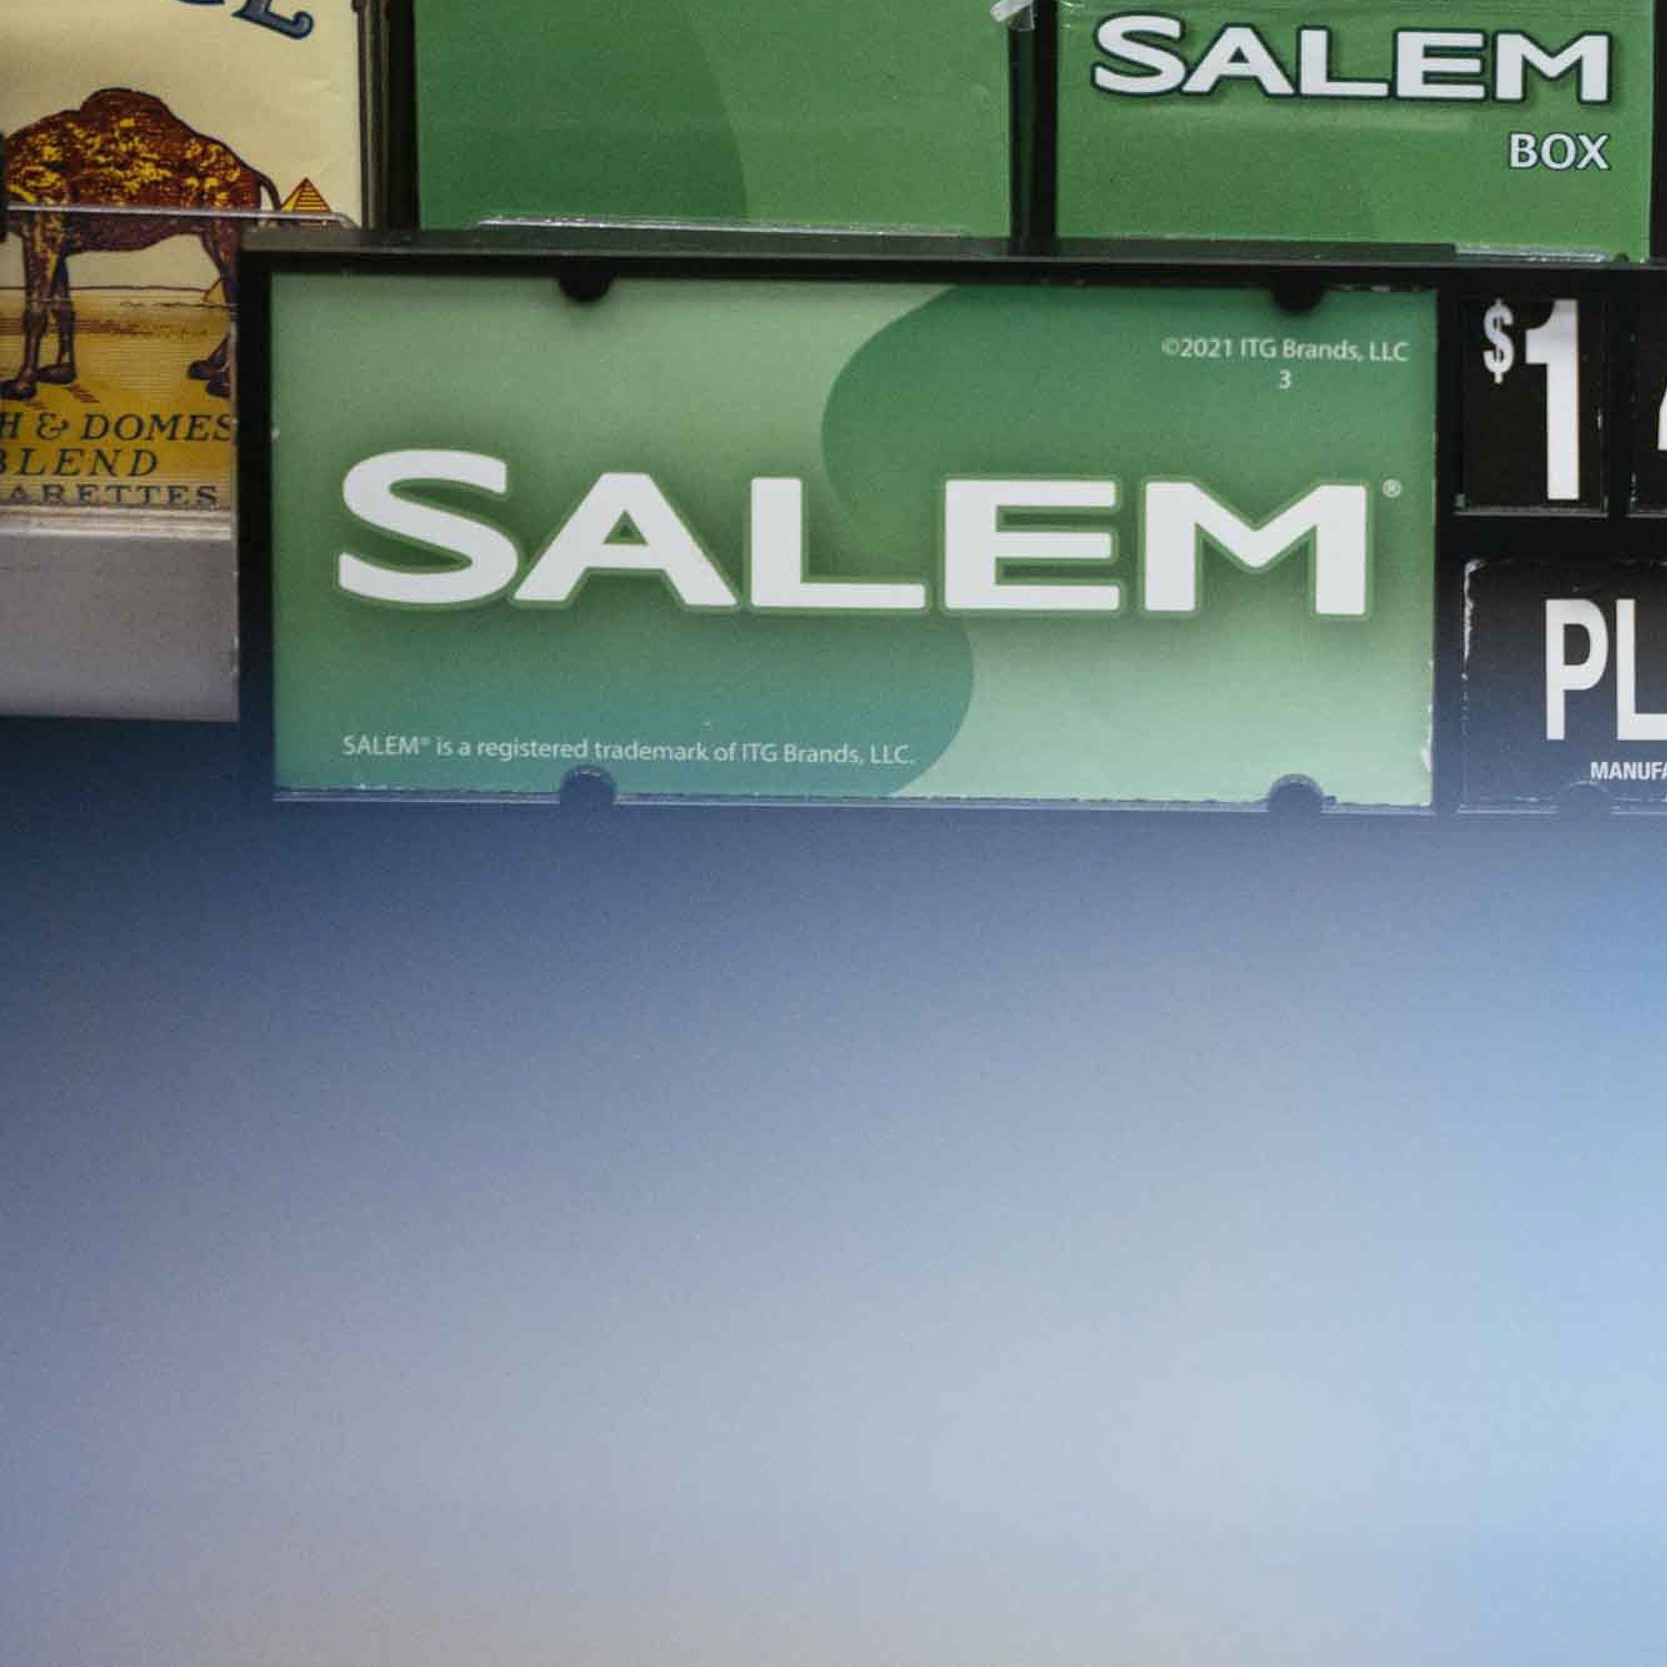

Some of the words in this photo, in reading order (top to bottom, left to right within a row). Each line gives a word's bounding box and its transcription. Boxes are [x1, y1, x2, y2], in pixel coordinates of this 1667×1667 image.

[1092, 13, 1611, 104] SALEM
[1509, 134, 1610, 171] BOX
[1241, 337, 1277, 359] ITG
[1281, 338, 1364, 363] Brands,
[1369, 341, 1411, 362] LLC
[1278, 369, 1292, 391] 3
[436, 736, 454, 756] is
[457, 742, 471, 756] a
[477, 738, 589, 762] registered
[595, 740, 709, 761] trademark
[714, 741, 738, 762] of
[742, 743, 777, 762] ITG
[784, 743, 865, 766] Brands,
[870, 744, 915, 765] LLC.
